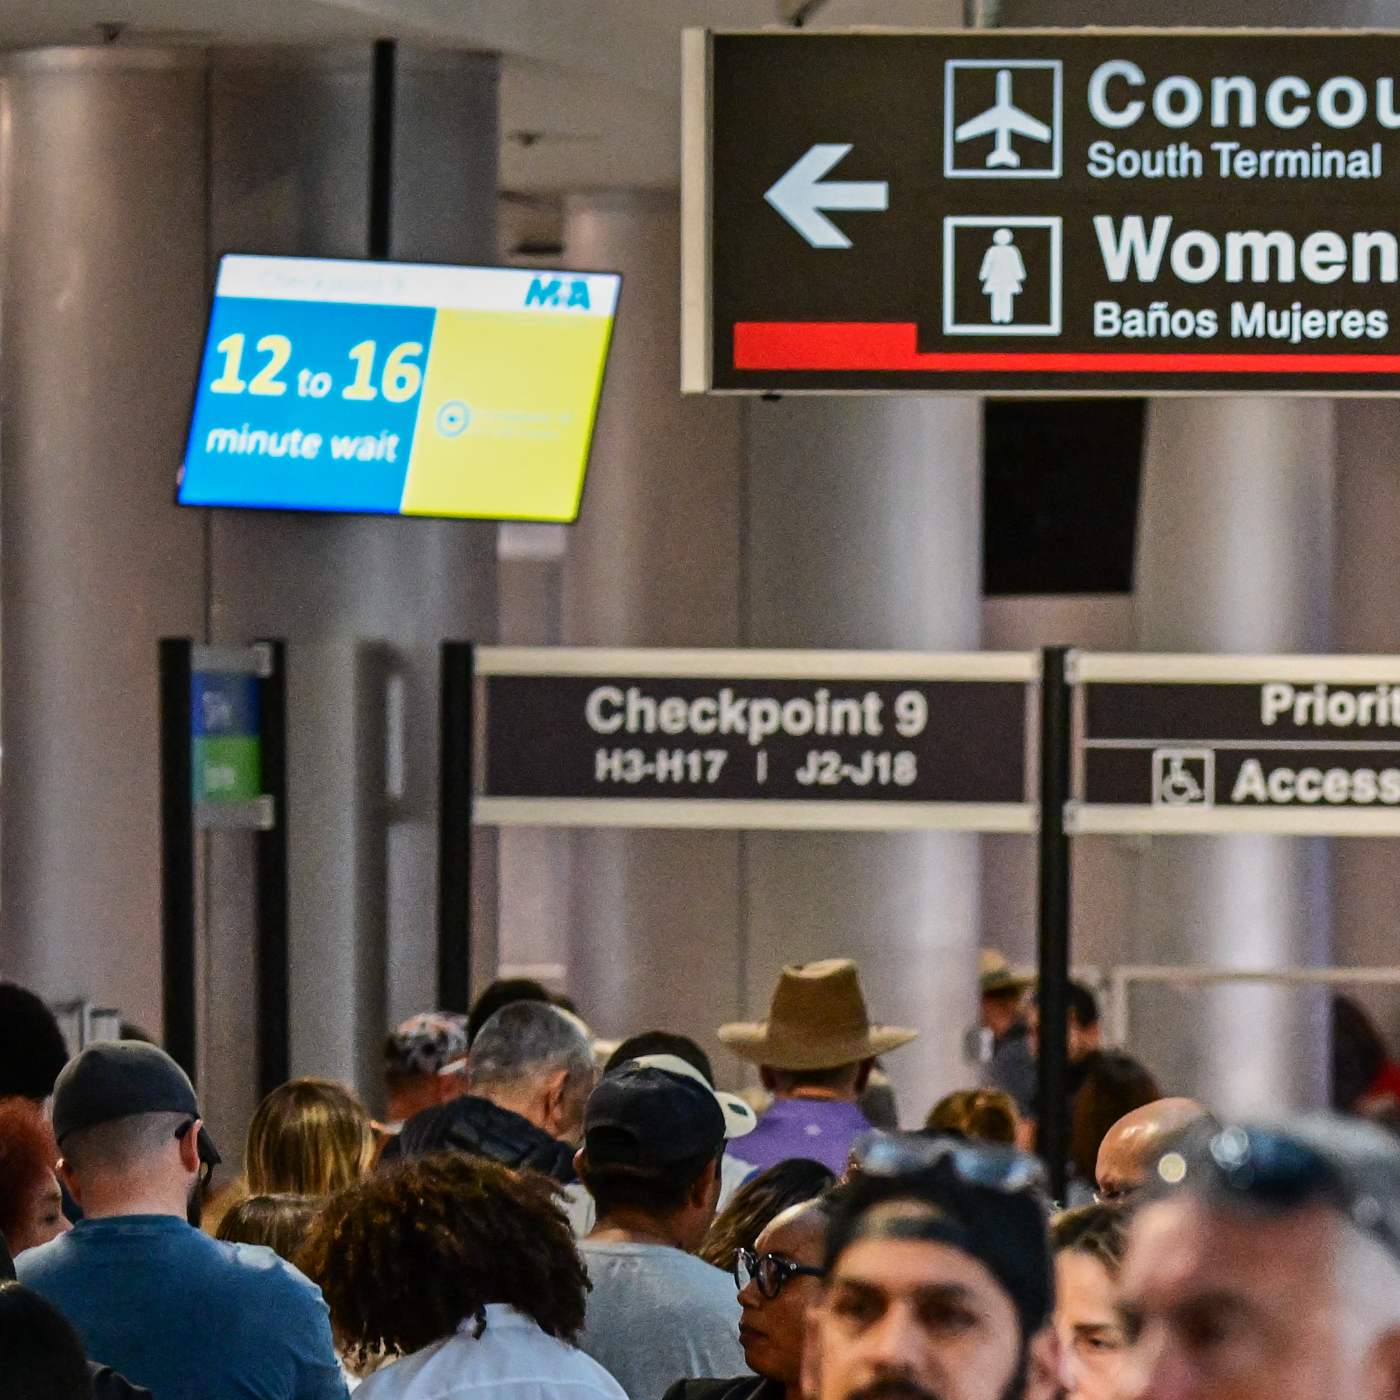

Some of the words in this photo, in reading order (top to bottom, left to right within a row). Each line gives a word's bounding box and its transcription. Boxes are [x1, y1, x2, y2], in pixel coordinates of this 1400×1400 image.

[1087, 140, 1203, 178] South
[1210, 141, 1382, 178] Terminal
[1093, 301, 1219, 338] Baños
[1231, 302, 1389, 344] Mujeres
[209, 332, 293, 396] 12
[297, 367, 333, 399] to
[341, 339, 424, 403] 16
[205, 423, 323, 460] minute
[330, 430, 401, 464] wait
[585, 686, 883, 746] Checkpoint
[895, 690, 929, 737] 9
[595, 748, 729, 783] H3-H17
[795, 750, 918, 786] J2-J18
